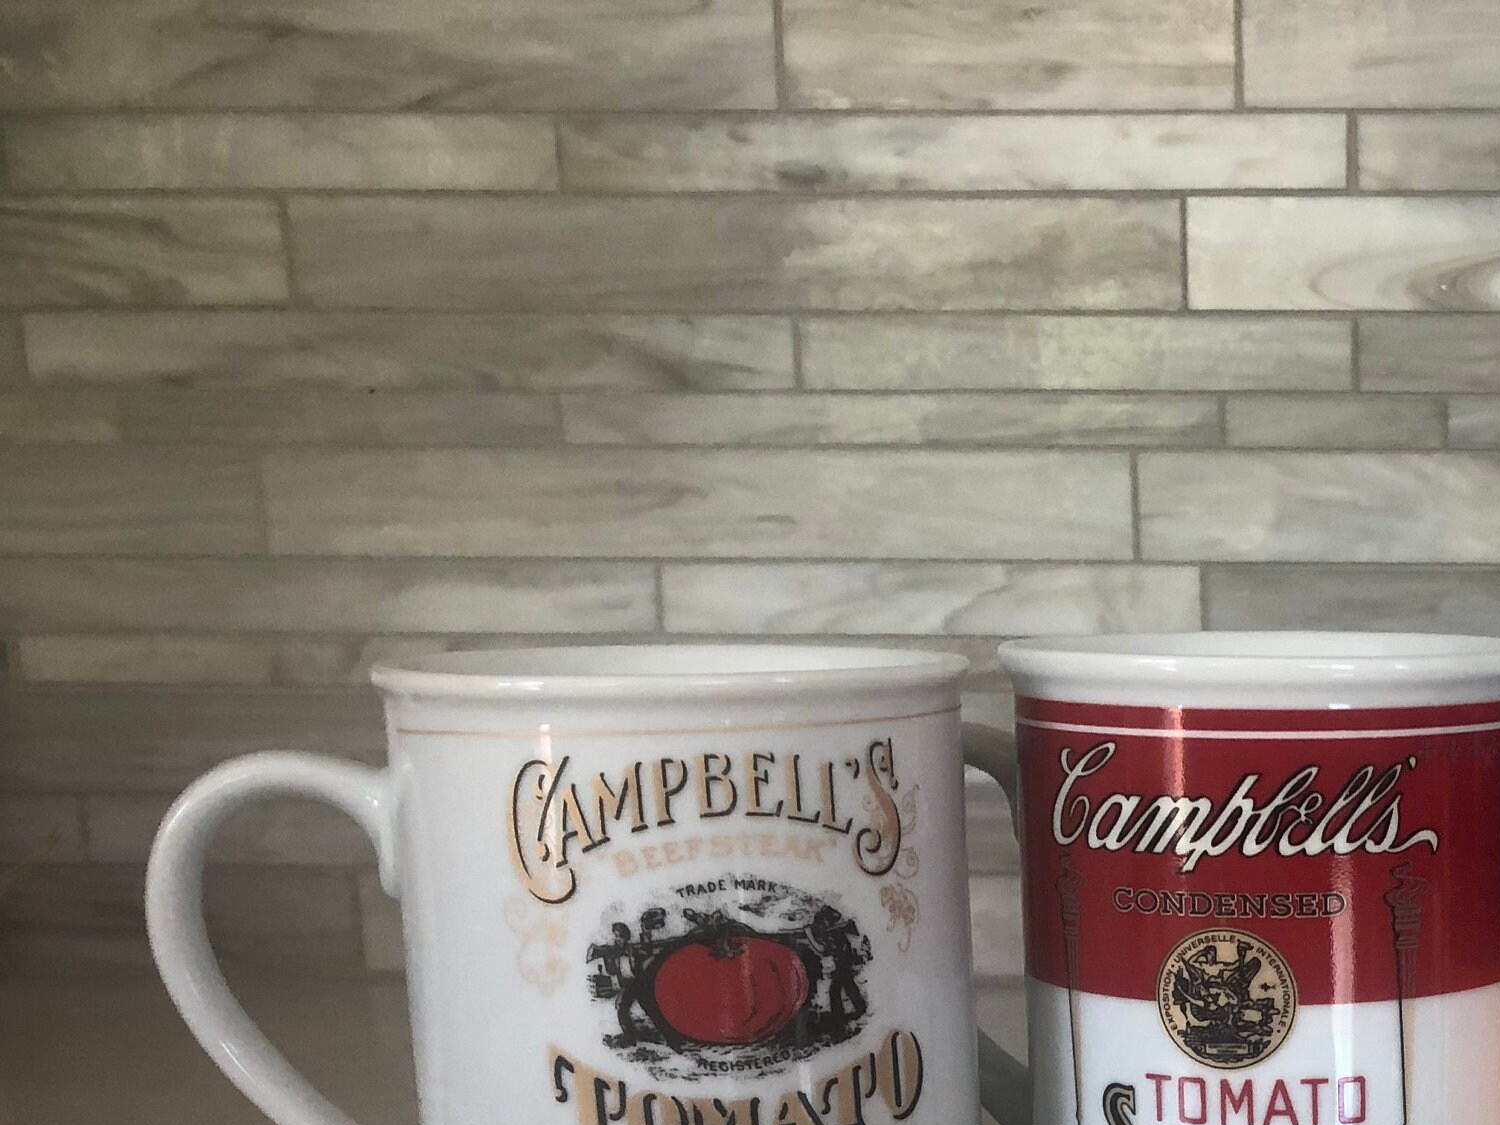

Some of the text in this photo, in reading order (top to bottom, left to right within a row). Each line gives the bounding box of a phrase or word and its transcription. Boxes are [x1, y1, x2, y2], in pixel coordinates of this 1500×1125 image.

[507, 738, 902, 905] CAMPBELL'S
[1052, 741, 1440, 873] Campbell's
[676, 877, 778, 899] TRADE MARK
[1111, 886, 1348, 919] CONDENSED
